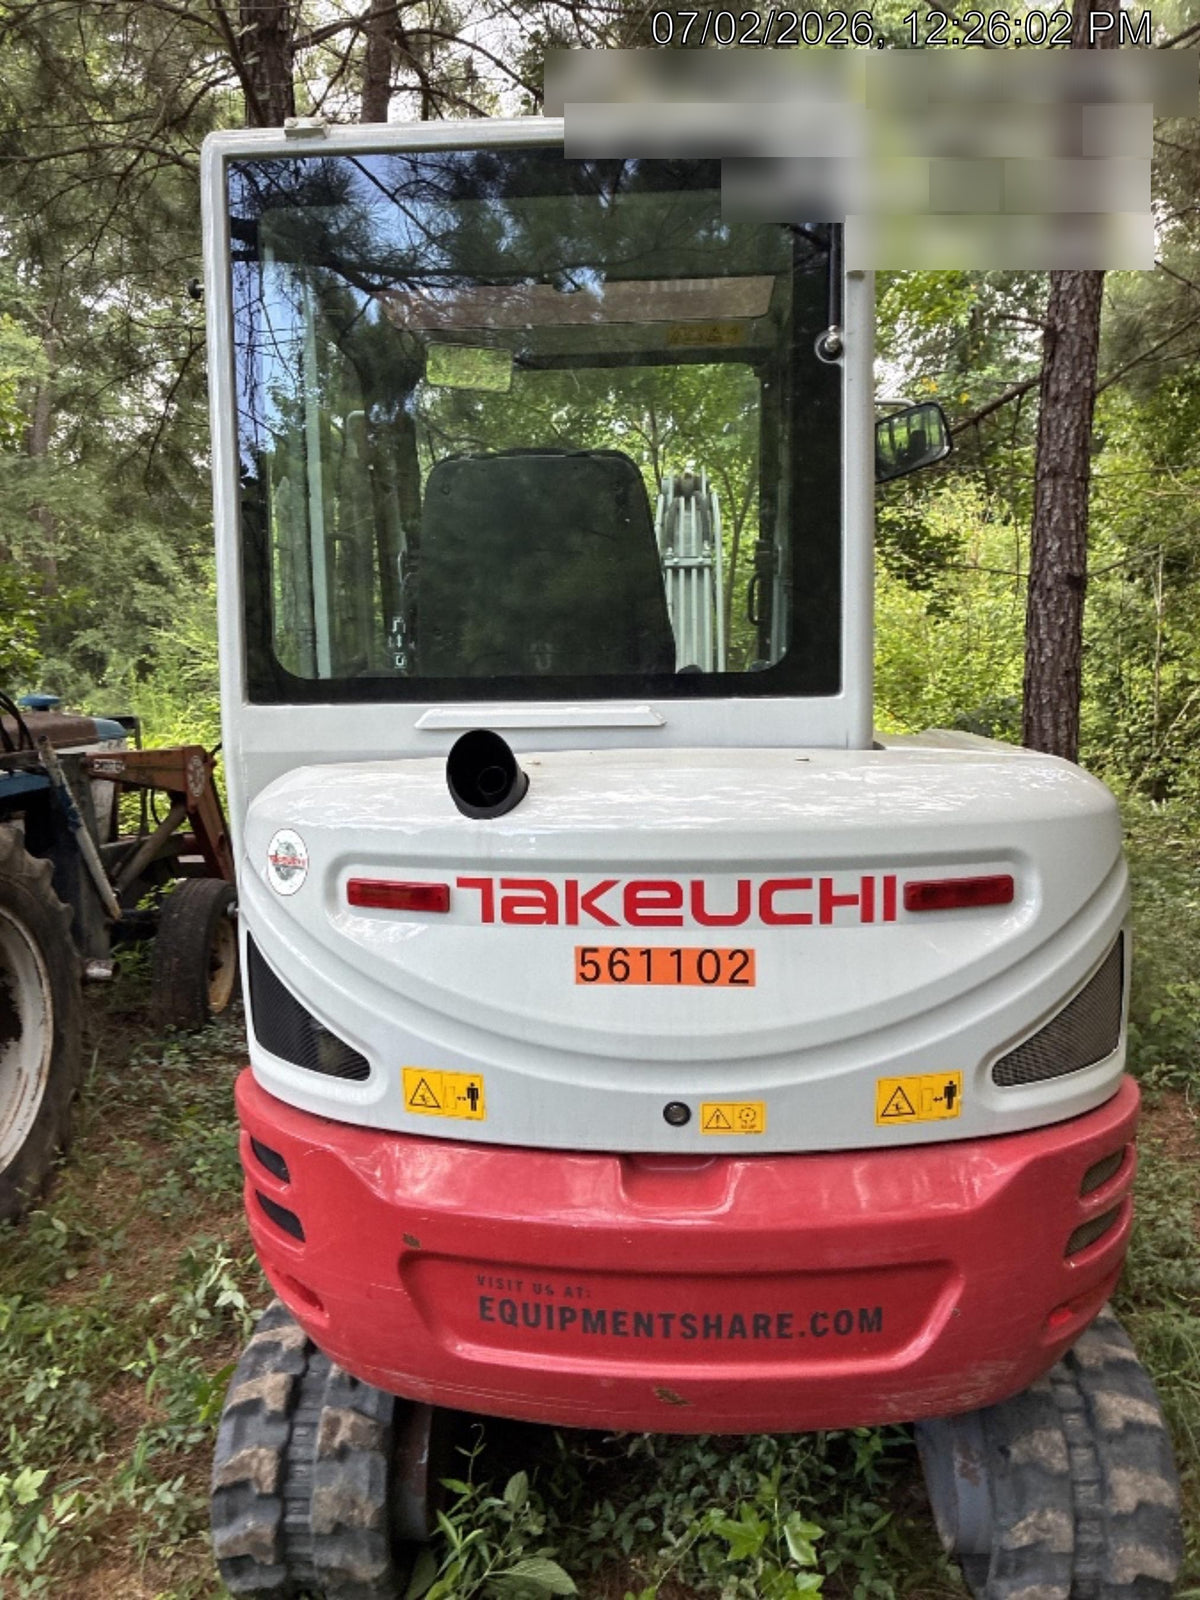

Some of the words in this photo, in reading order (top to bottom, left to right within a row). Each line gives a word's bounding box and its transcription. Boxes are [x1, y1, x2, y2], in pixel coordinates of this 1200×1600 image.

[579, 947, 751, 986] 561102
[476, 1274, 523, 1292] VISIT
[532, 1282, 555, 1297] US
[563, 1285, 592, 1299] AT:
[478, 1295, 884, 1340] EQUIPMENTSHARE.COM
